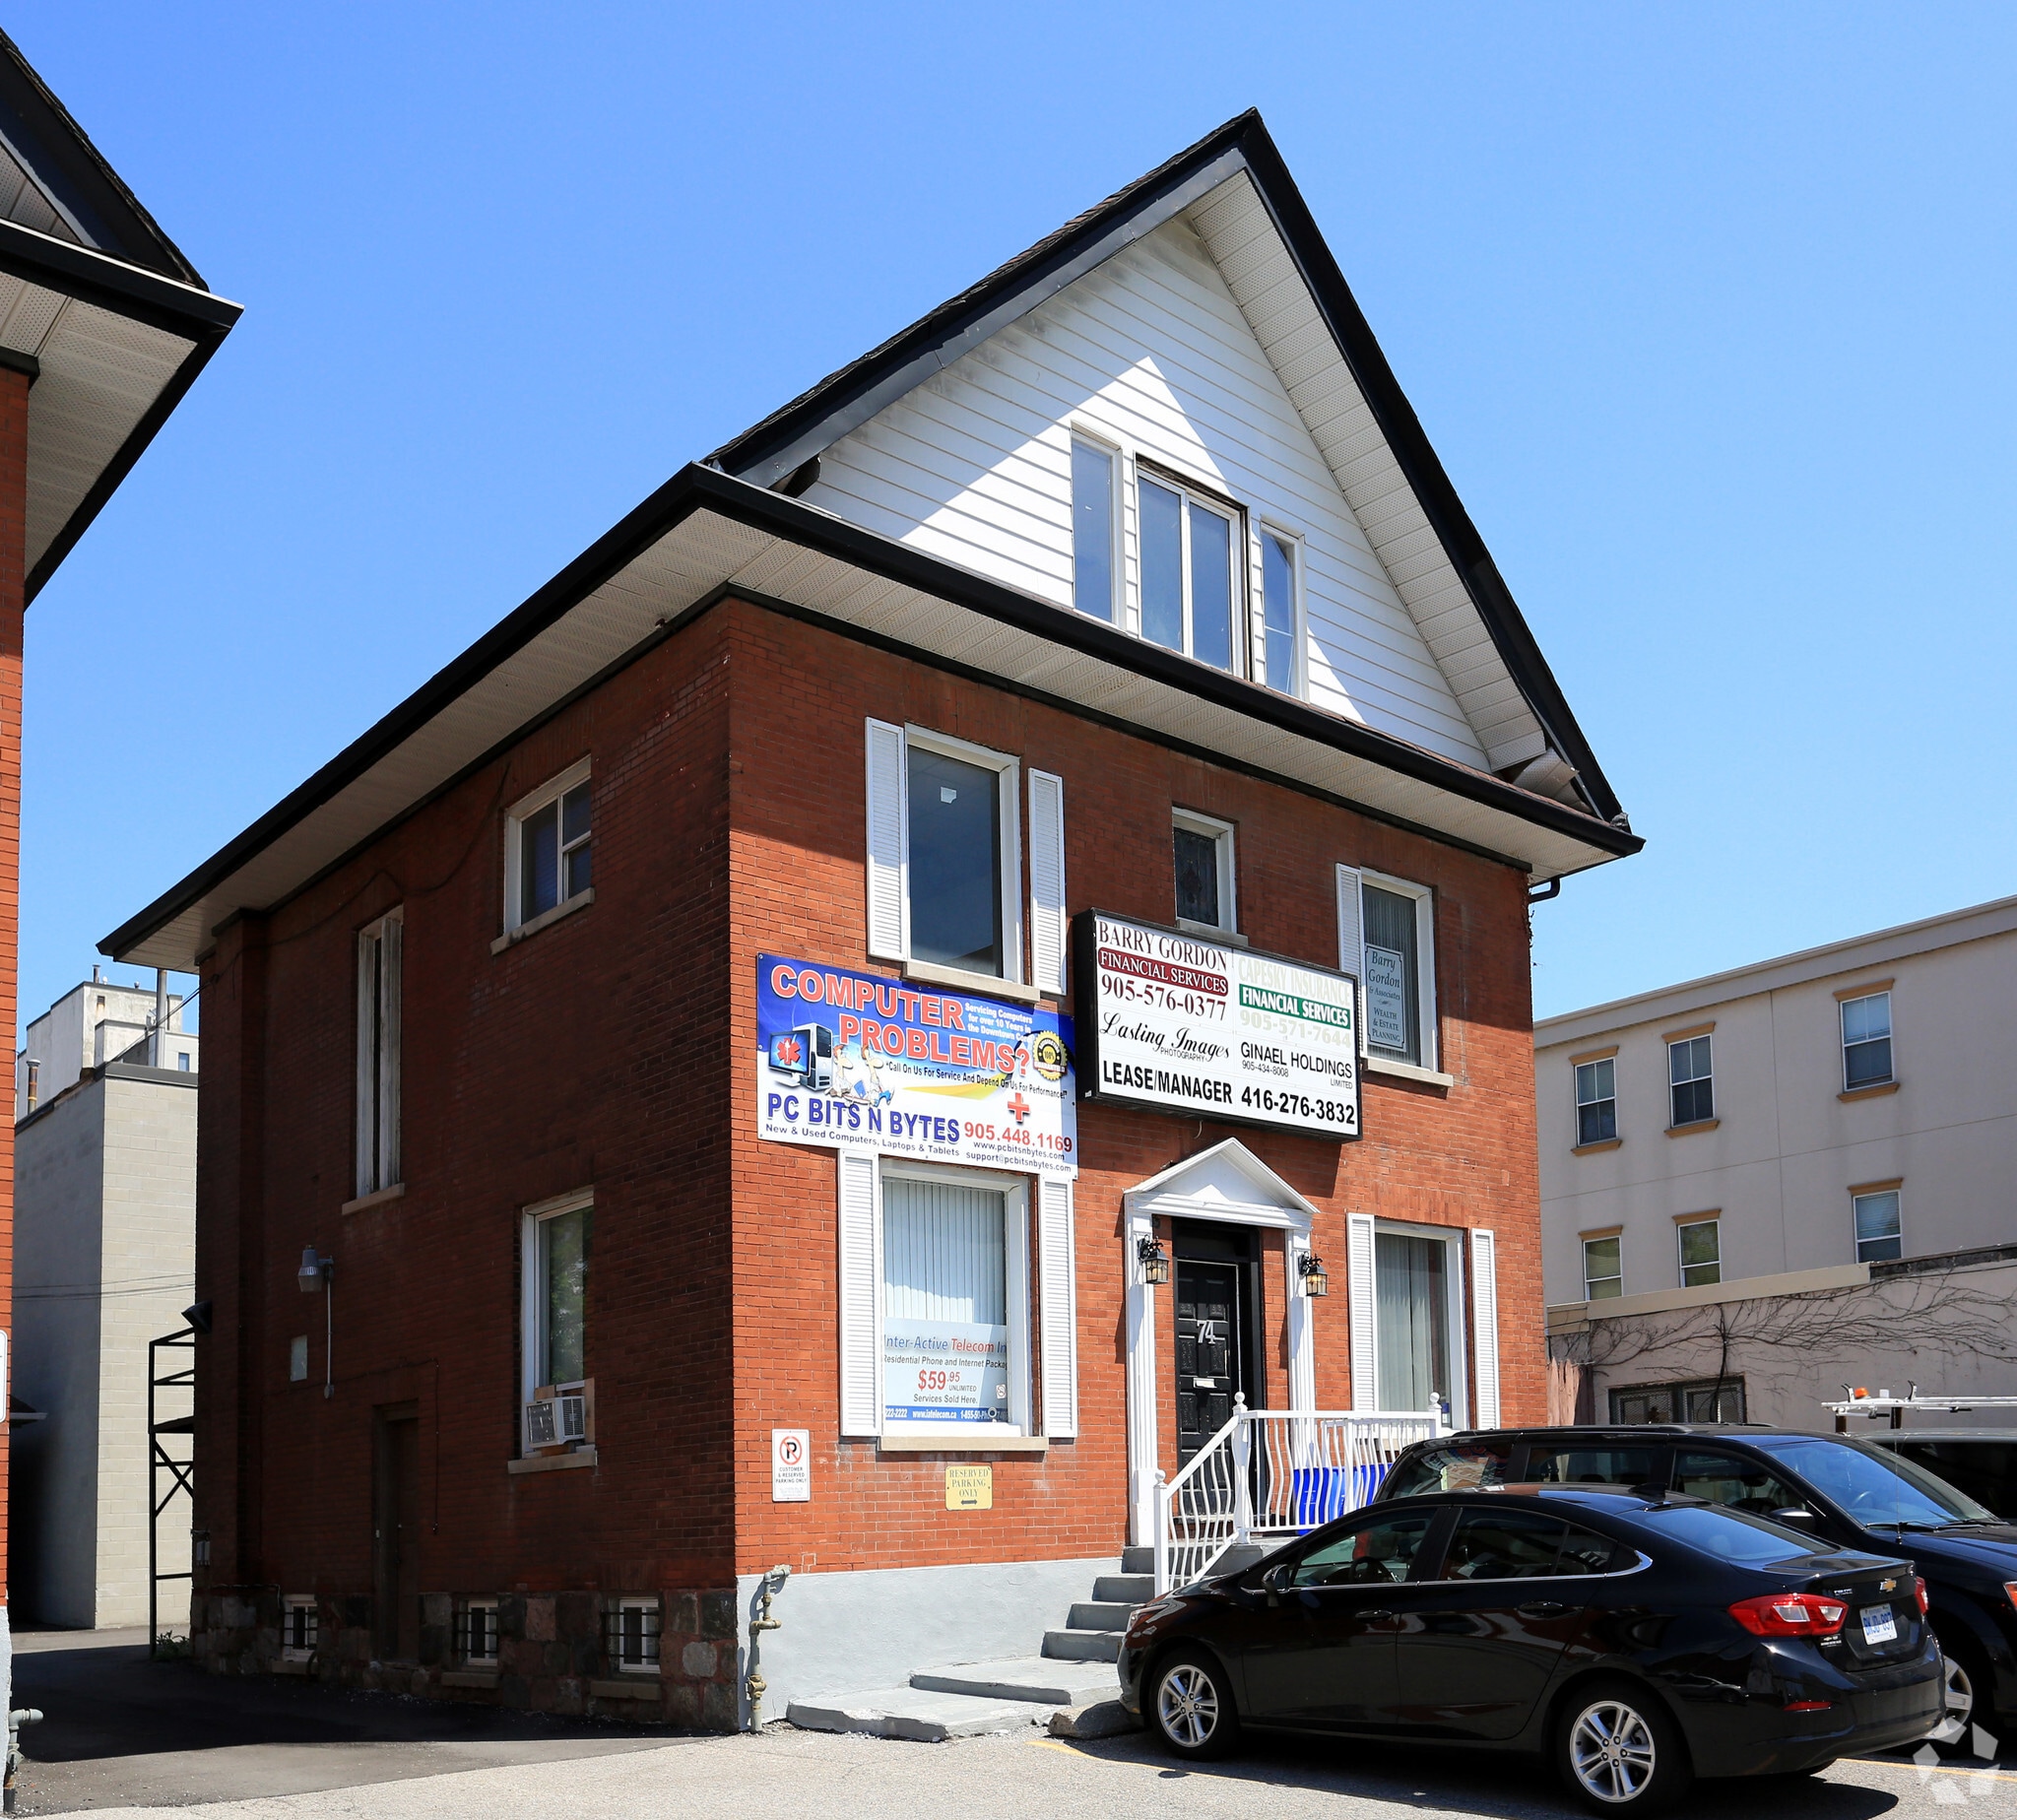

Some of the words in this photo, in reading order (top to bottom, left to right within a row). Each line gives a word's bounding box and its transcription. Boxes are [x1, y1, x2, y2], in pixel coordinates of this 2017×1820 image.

[1099, 921, 1154, 954] BARRY
[1158, 934, 1227, 971] GORDON
[1100, 950, 1169, 981] FINANCIAL
[1171, 968, 1227, 994] SERVICES
[1372, 951, 1396, 972] Barry
[1239, 956, 1287, 991] CAPESKY
[1291, 969, 1350, 1007] INSURANCE
[1368, 969, 1400, 989] Gordon
[771, 965, 965, 1030] COMPUTER
[1101, 973, 1227, 1021] 905-576-0377
[1375, 987, 1400, 1001] Associates
[965, 1003, 997, 1018] Servicing
[998, 1008, 1033, 1024] Computers
[1242, 987, 1300, 1015] FINANCIAL
[1303, 1001, 1348, 1026] SERVICES
[968, 1013, 979, 1022] for
[979, 1017, 994, 1026] over
[996, 1018, 1004, 1028] 10
[1005, 1019, 1024, 1032] Years
[1024, 1024, 1032, 1033] in
[968, 1023, 980, 1033] the
[980, 1025, 1015, 1040] Downtown
[1240, 1009, 1351, 1048] 905-571-7644
[839, 1013, 1031, 1077] PROBLEMS?
[1099, 1011, 1166, 1052] Lasting
[1171, 1026, 1230, 1062] Images
[1372, 1028, 1400, 1042] PLANNING
[1160, 1047, 1205, 1063] PHOTOGRAPHY
[1240, 1041, 1287, 1067] GINAEL
[1290, 1051, 1352, 1078] HOLDINGS
[902, 1064, 912, 1074] On
[913, 1066, 923, 1075] Us
[924, 1067, 935, 1077] For
[936, 1070, 961, 1081] Service
[962, 1073, 975, 1083] And
[976, 1076, 1000, 1088] Depend
[1001, 1078, 1009, 1088] On
[1010, 1080, 1018, 1090] Us
[1018, 1082, 1028, 1091] For
[1242, 1060, 1289, 1078] 905-434-8008
[1103, 1060, 1233, 1105] LEASE/MANAGER
[1331, 1078, 1352, 1090] LIMITED
[1241, 1086, 1355, 1125] 416-276-3832
[768, 1093, 799, 1121] PC
[809, 1098, 861, 1130] BITS
[869, 1107, 882, 1132] N
[889, 1111, 960, 1143] BYTES
[766, 1124, 788, 1135] New
[802, 1128, 825, 1138] Used
[828, 1132, 879, 1146] Computers,
[882, 1138, 916, 1152] Laptops
[919, 1142, 925, 1151] &
[928, 1144, 960, 1156] Tablets
[964, 1122, 1073, 1152] 905.448.1169
[973, 1140, 1065, 1160] www.pcbitsnbytes.com
[966, 1151, 1072, 1173] support@pcbitsnbytes.com
[1197, 1320, 1216, 1344] 74
[951, 1337, 995, 1352] Telecom
[922, 1356, 943, 1366] Phone
[944, 1357, 957, 1366] and
[958, 1358, 985, 1368] Internet
[913, 1394, 943, 1403] Services
[944, 1395, 959, 1403] Sold
[961, 1396, 978, 1404] Here.
[948, 1384, 977, 1393] UNLIMITED
[949, 1468, 989, 1477] RESERVED
[959, 1488, 978, 1497] ONLY
